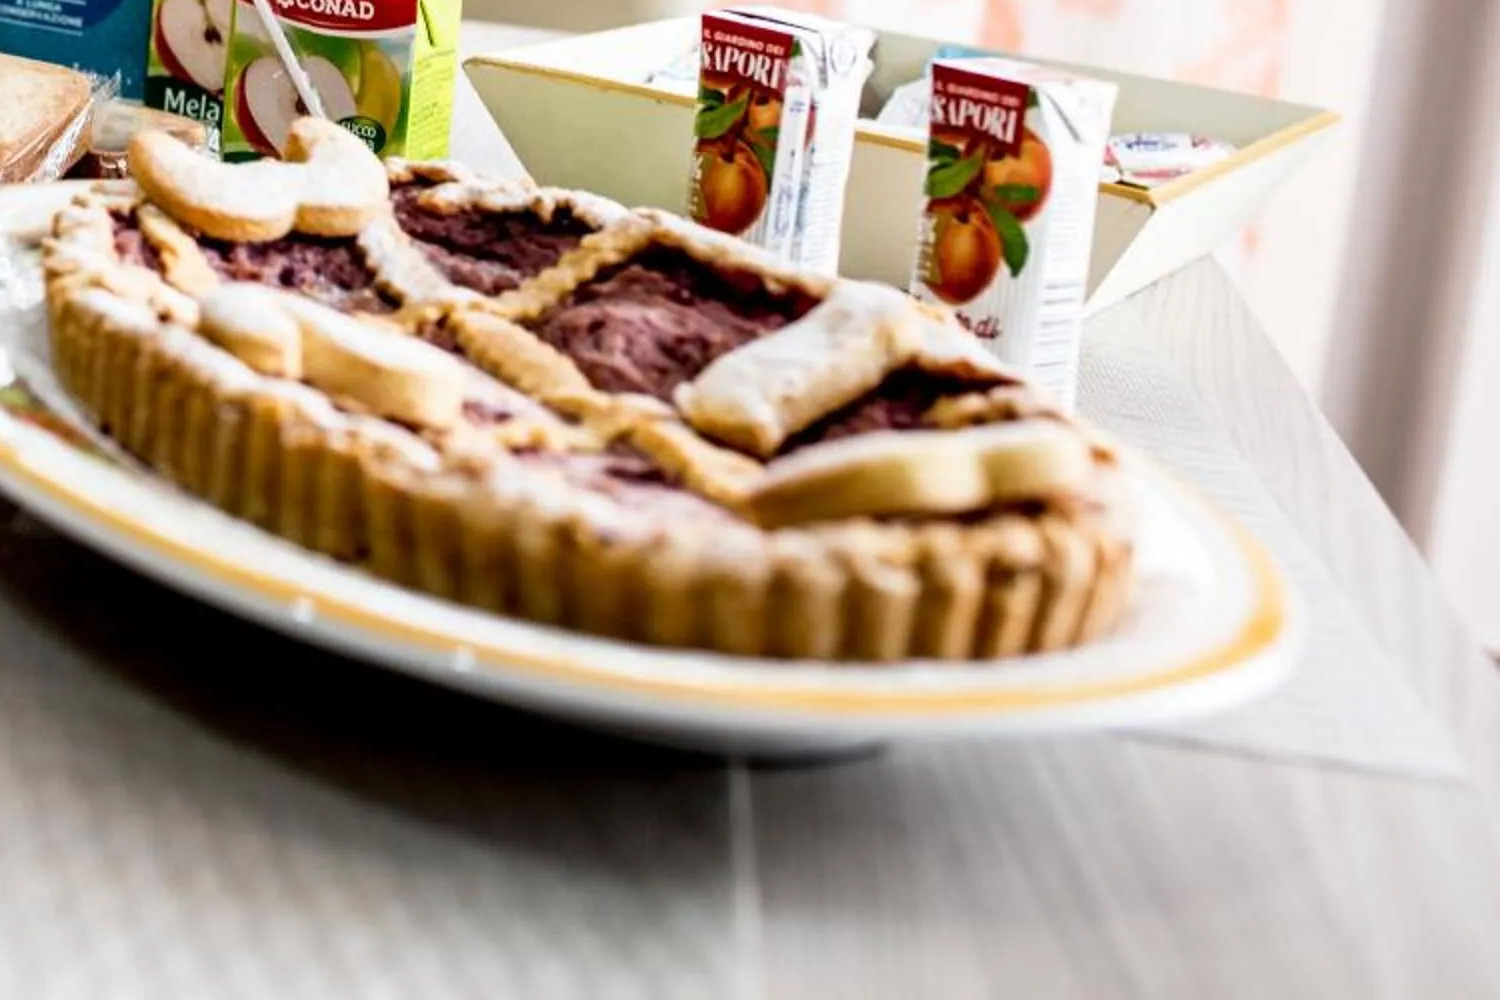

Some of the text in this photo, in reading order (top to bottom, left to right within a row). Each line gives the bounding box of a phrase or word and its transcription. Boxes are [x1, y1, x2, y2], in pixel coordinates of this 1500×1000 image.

[713, 31, 765, 52] GIARDINO
[700, 40, 785, 90] SAPORI
[162, 87, 221, 122] Mela
[929, 93, 1019, 145] SAPORI
